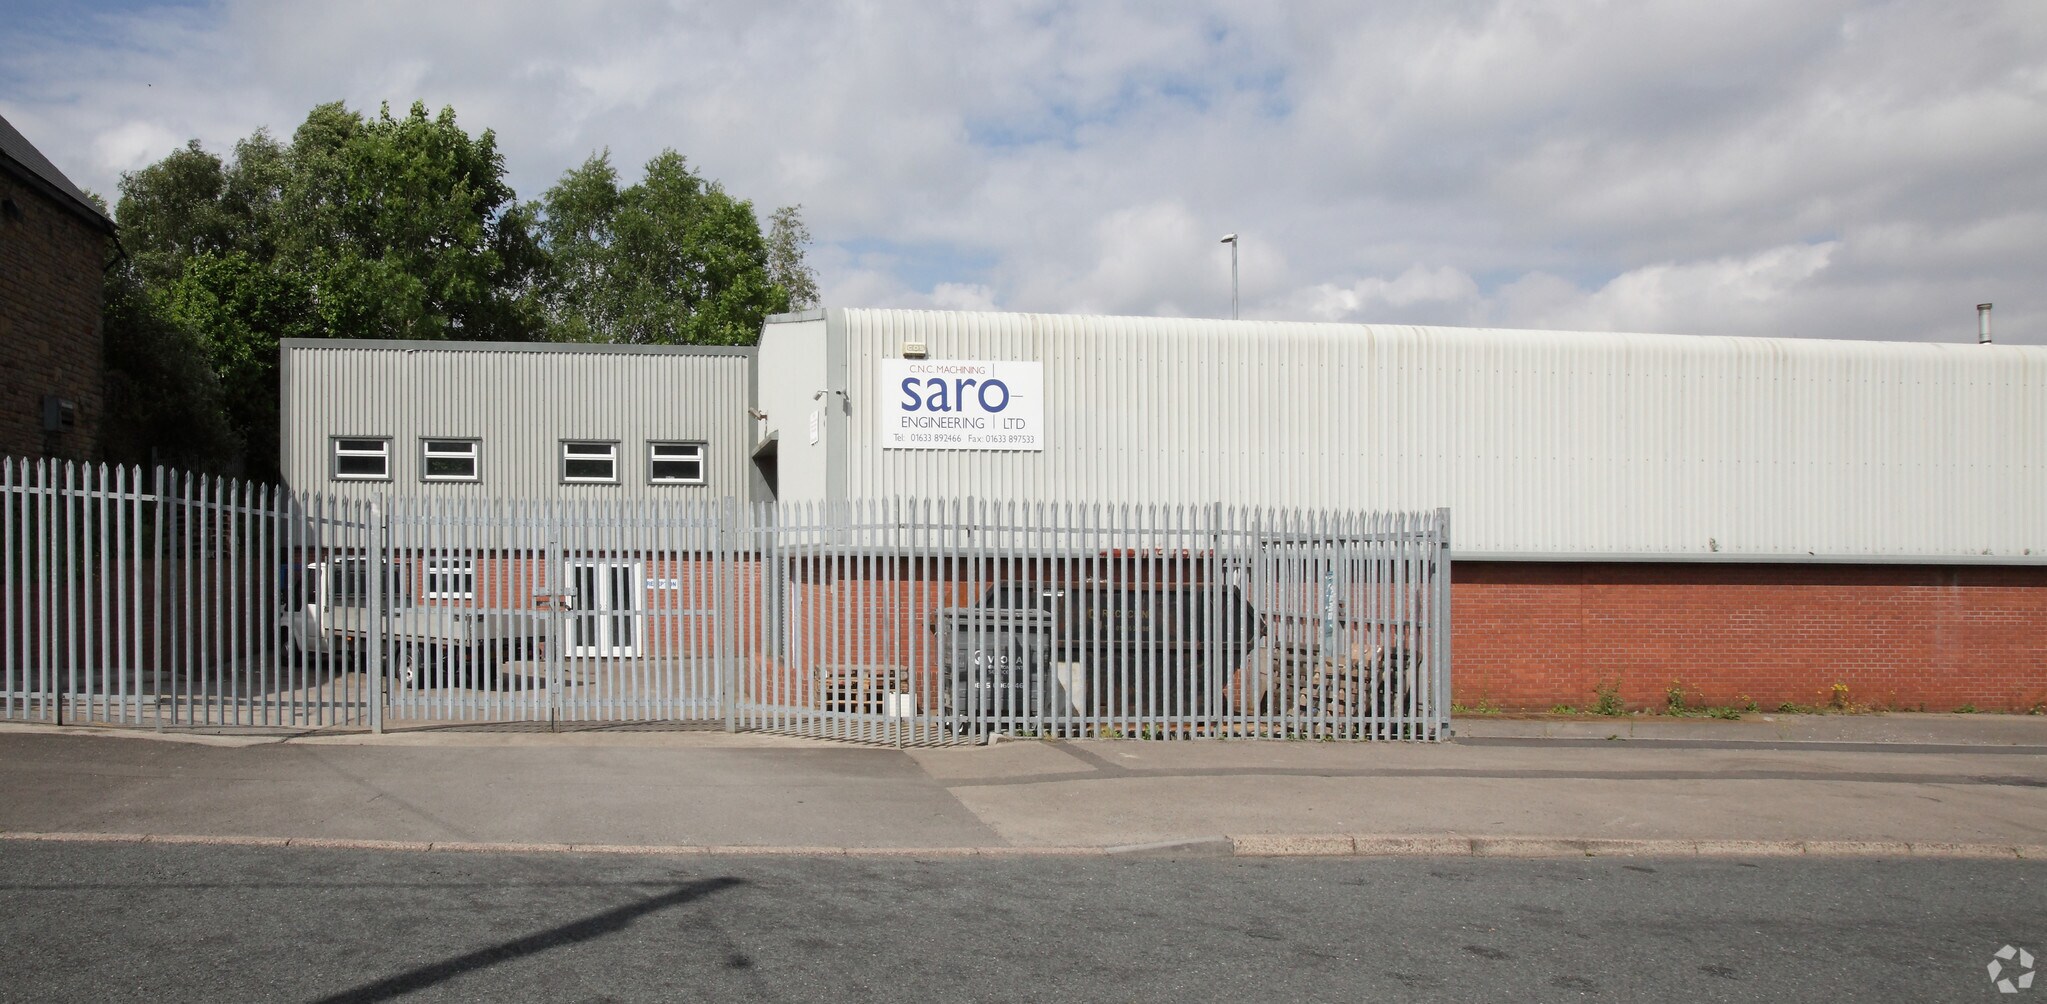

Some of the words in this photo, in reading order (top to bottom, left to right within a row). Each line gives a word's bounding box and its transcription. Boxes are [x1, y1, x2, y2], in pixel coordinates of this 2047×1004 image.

[936, 365, 986, 375] MACHINING
[901, 377, 1010, 413] saro
[901, 416, 985, 430] ENGINEERING
[1003, 418, 1026, 430] LTD
[910, 434, 932, 442] 01633
[934, 434, 962, 442] 892466
[985, 435, 1007, 443] 01633
[1008, 435, 1035, 443] 897533
[987, 655, 1023, 664] VOA
